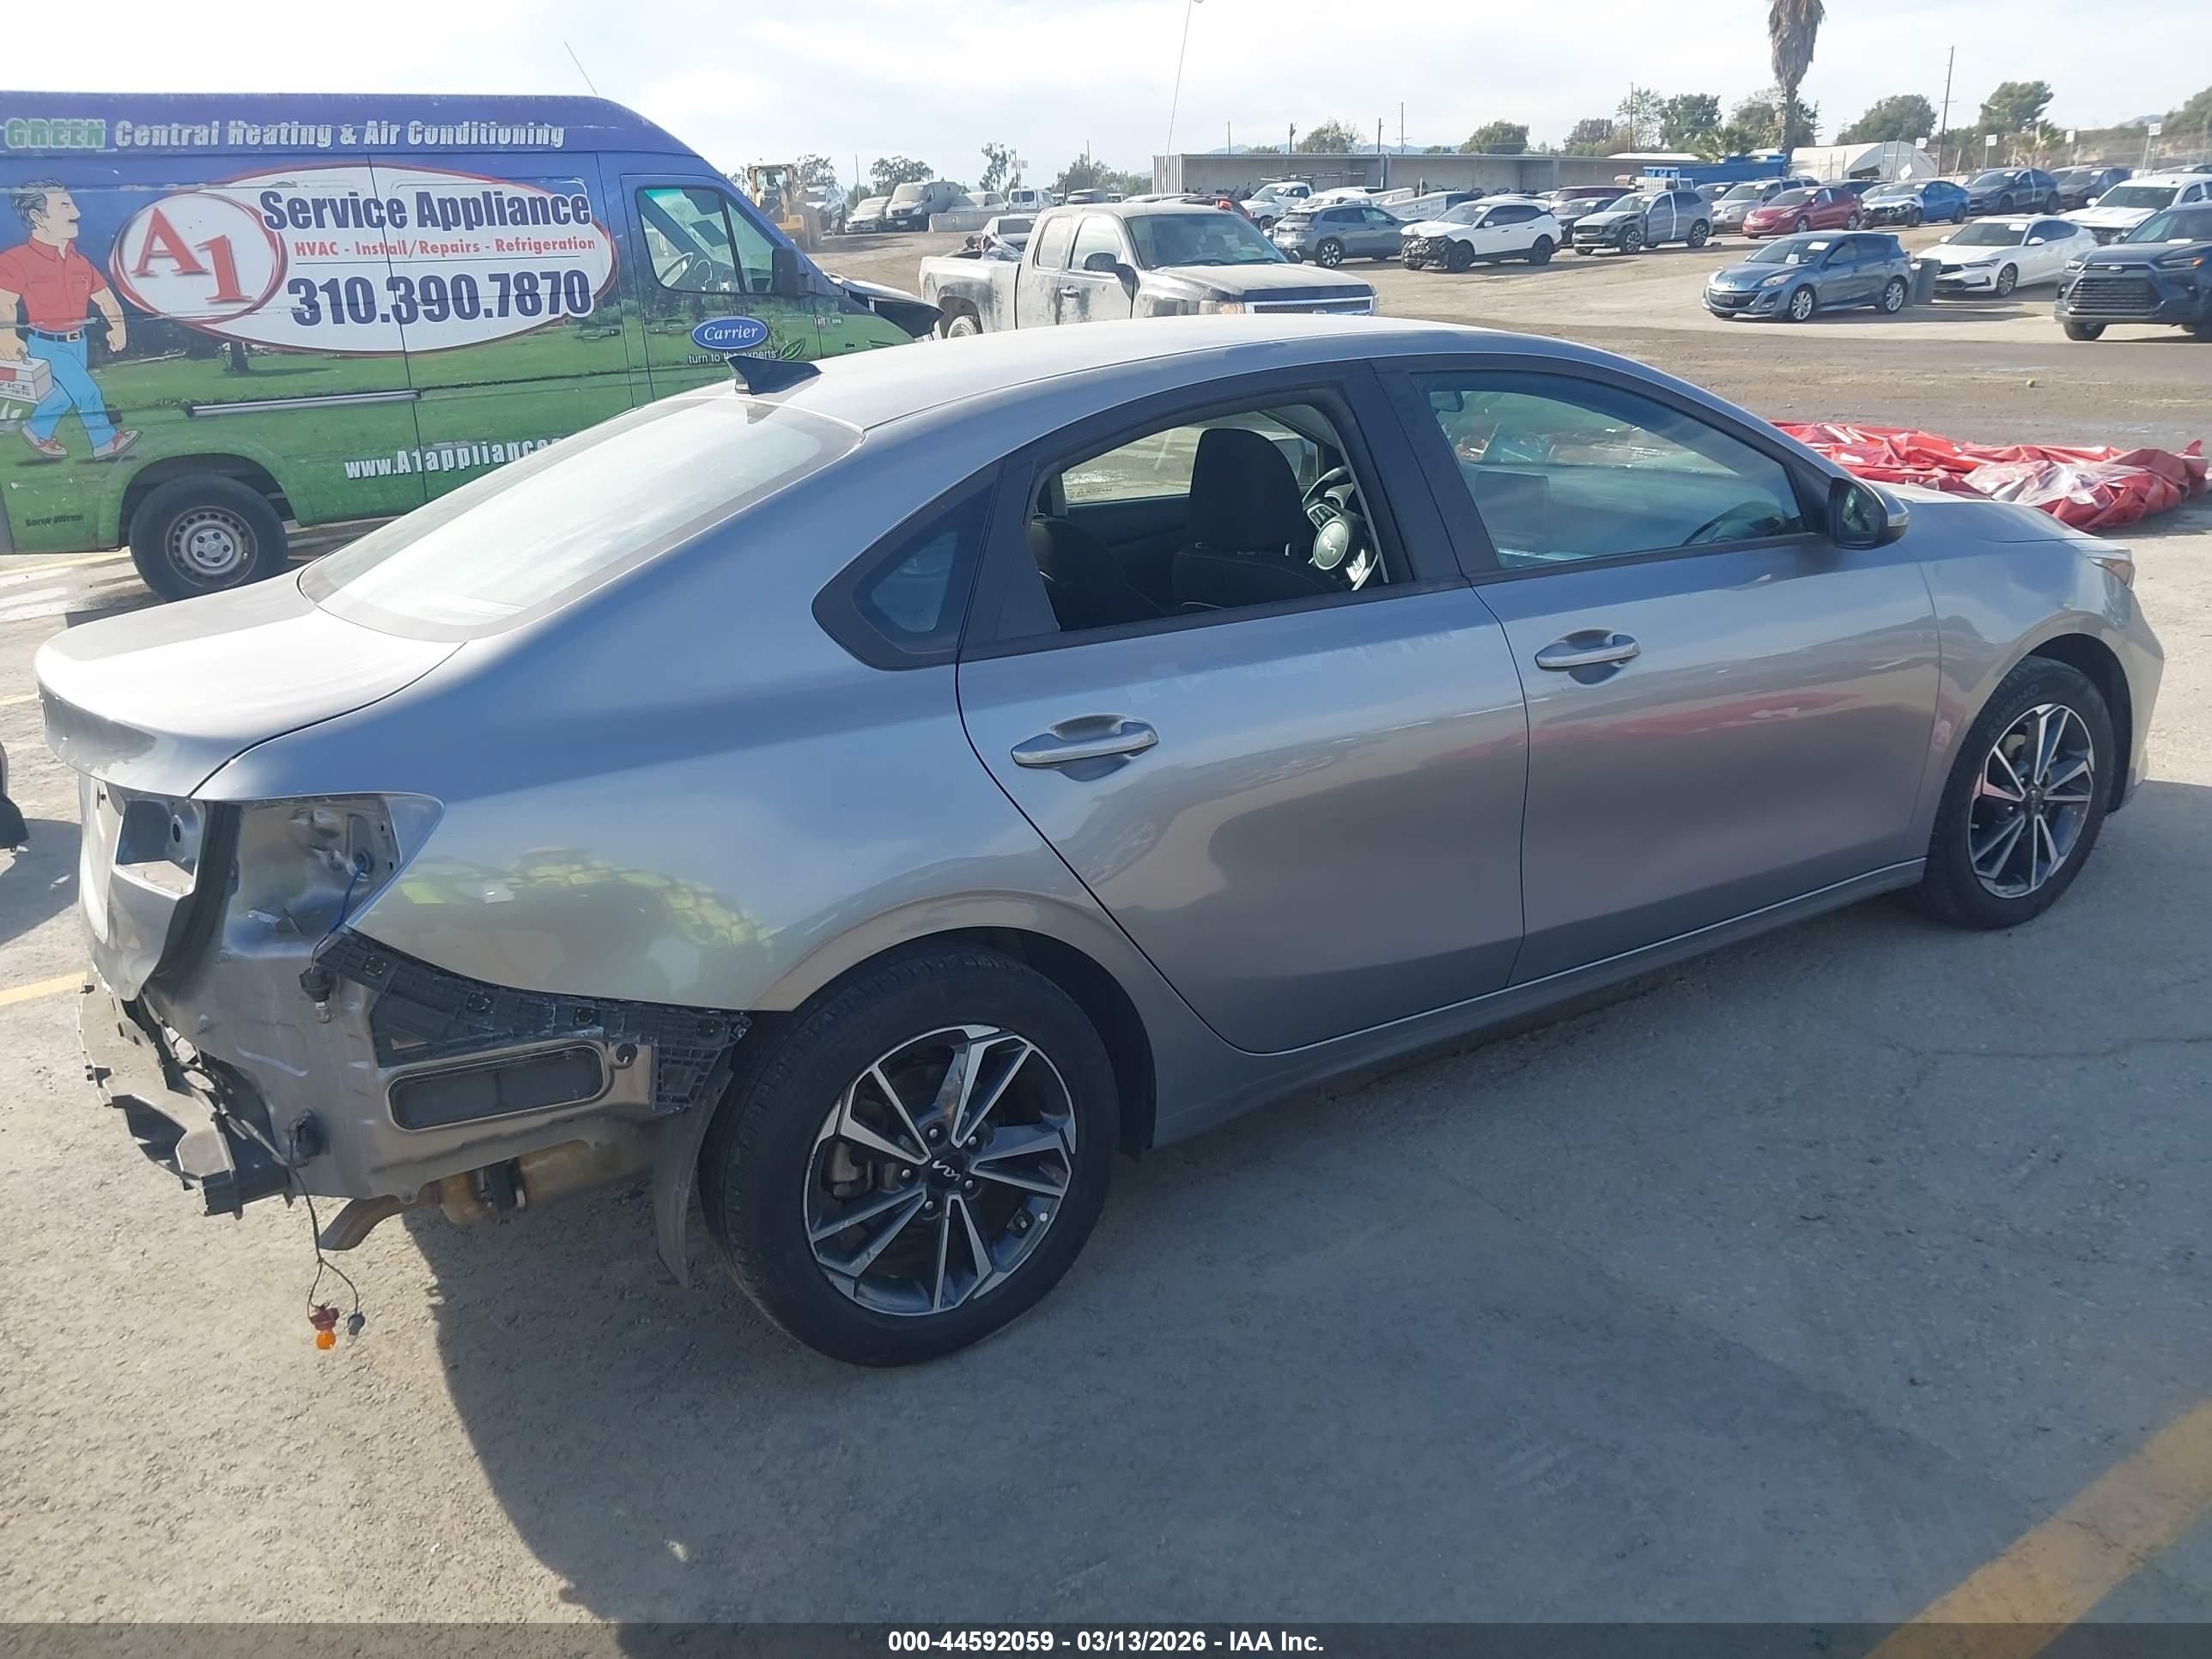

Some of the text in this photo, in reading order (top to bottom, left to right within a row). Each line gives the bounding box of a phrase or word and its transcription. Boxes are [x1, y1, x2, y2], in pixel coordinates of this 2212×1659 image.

[6, 118, 565, 149] GREEN Central Heating & Air Conditioning
[260, 191, 591, 231] Service Appliance
[131, 206, 252, 304] A1
[295, 241, 339, 256] HVAC
[355, 239, 480, 258] Install/Repairs
[495, 236, 595, 255] Refrigeration
[288, 270, 592, 326] 310.390.7870
[704, 325, 758, 341] Carrier
[688, 354, 708, 364] turn
[711, 352, 720, 362] to
